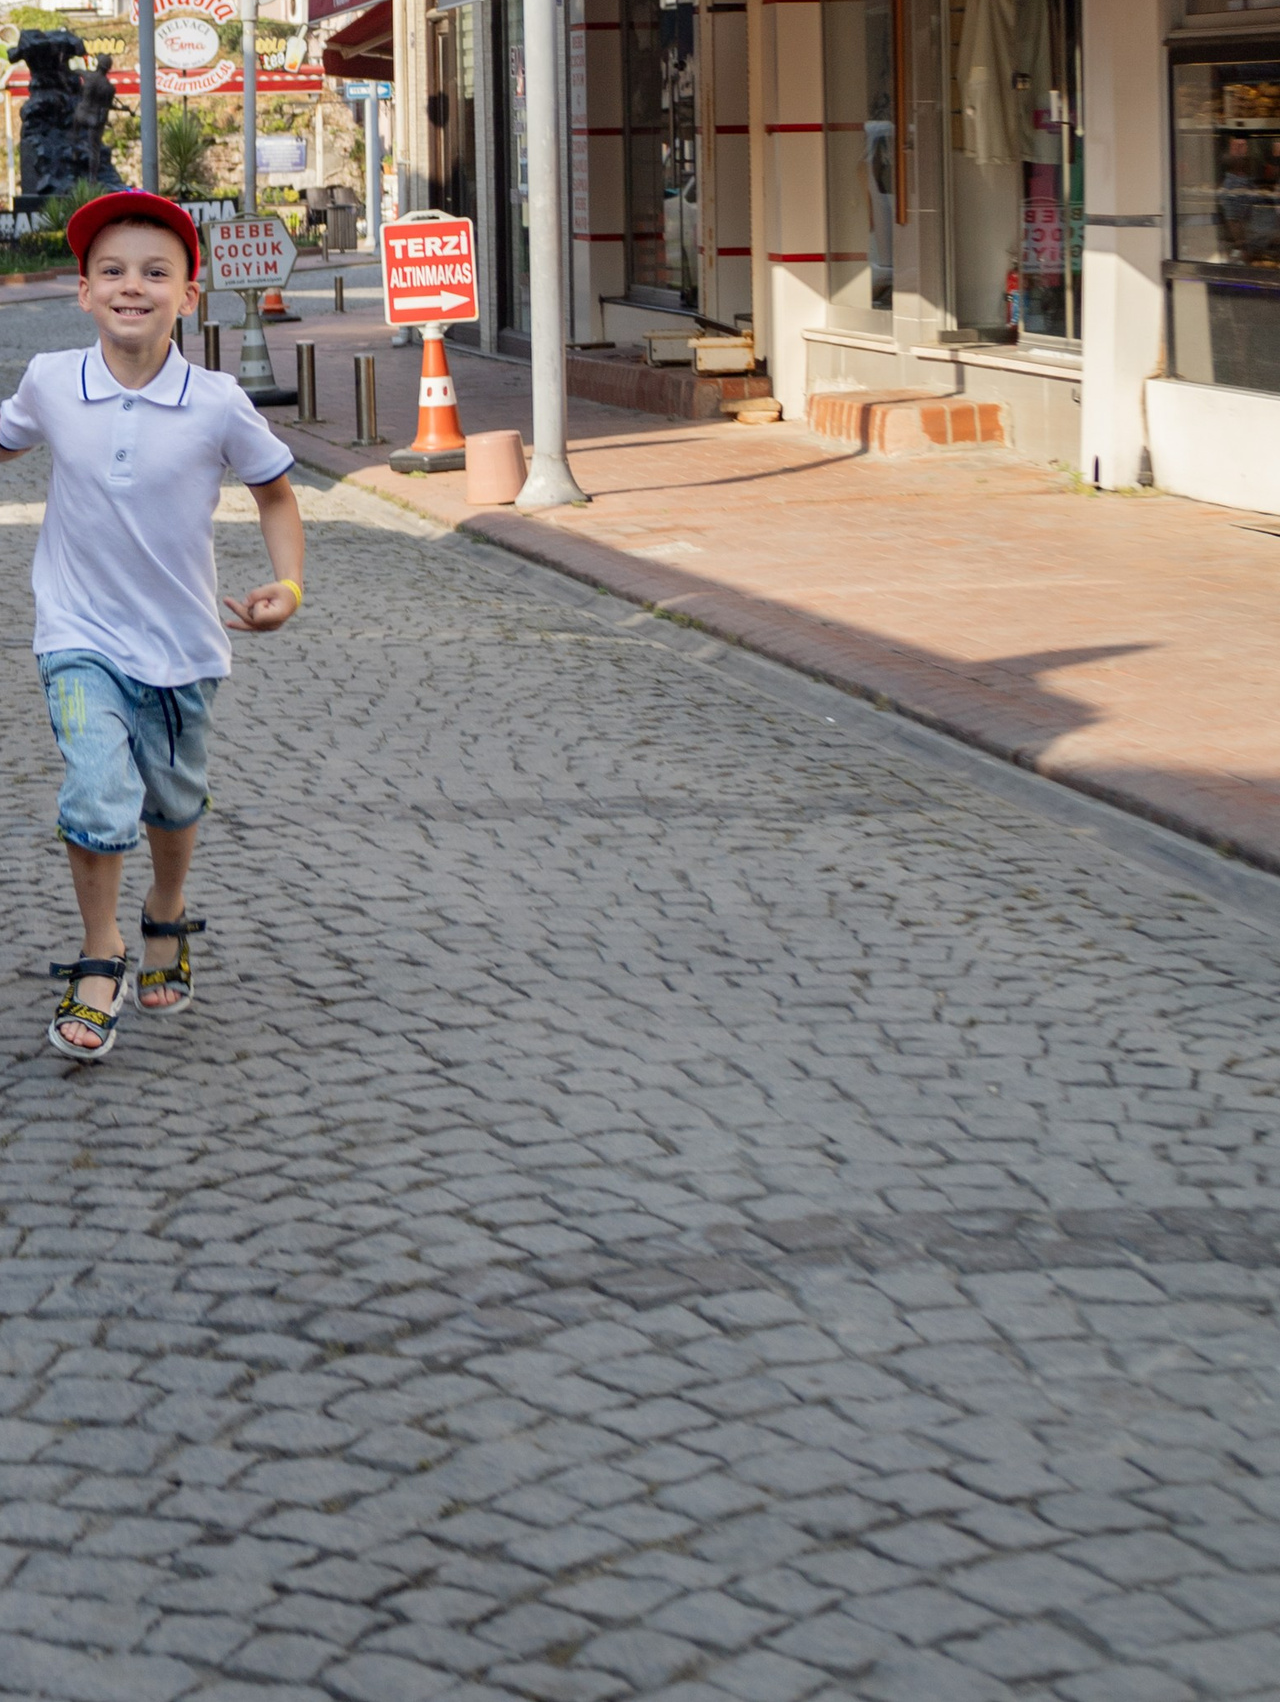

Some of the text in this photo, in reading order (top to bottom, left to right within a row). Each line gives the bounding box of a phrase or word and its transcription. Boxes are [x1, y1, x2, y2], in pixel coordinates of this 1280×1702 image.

[220, 222, 274, 240] BEBE
[214, 240, 283, 261] ÇOCUK
[390, 263, 472, 289] ALTINMAKAS
